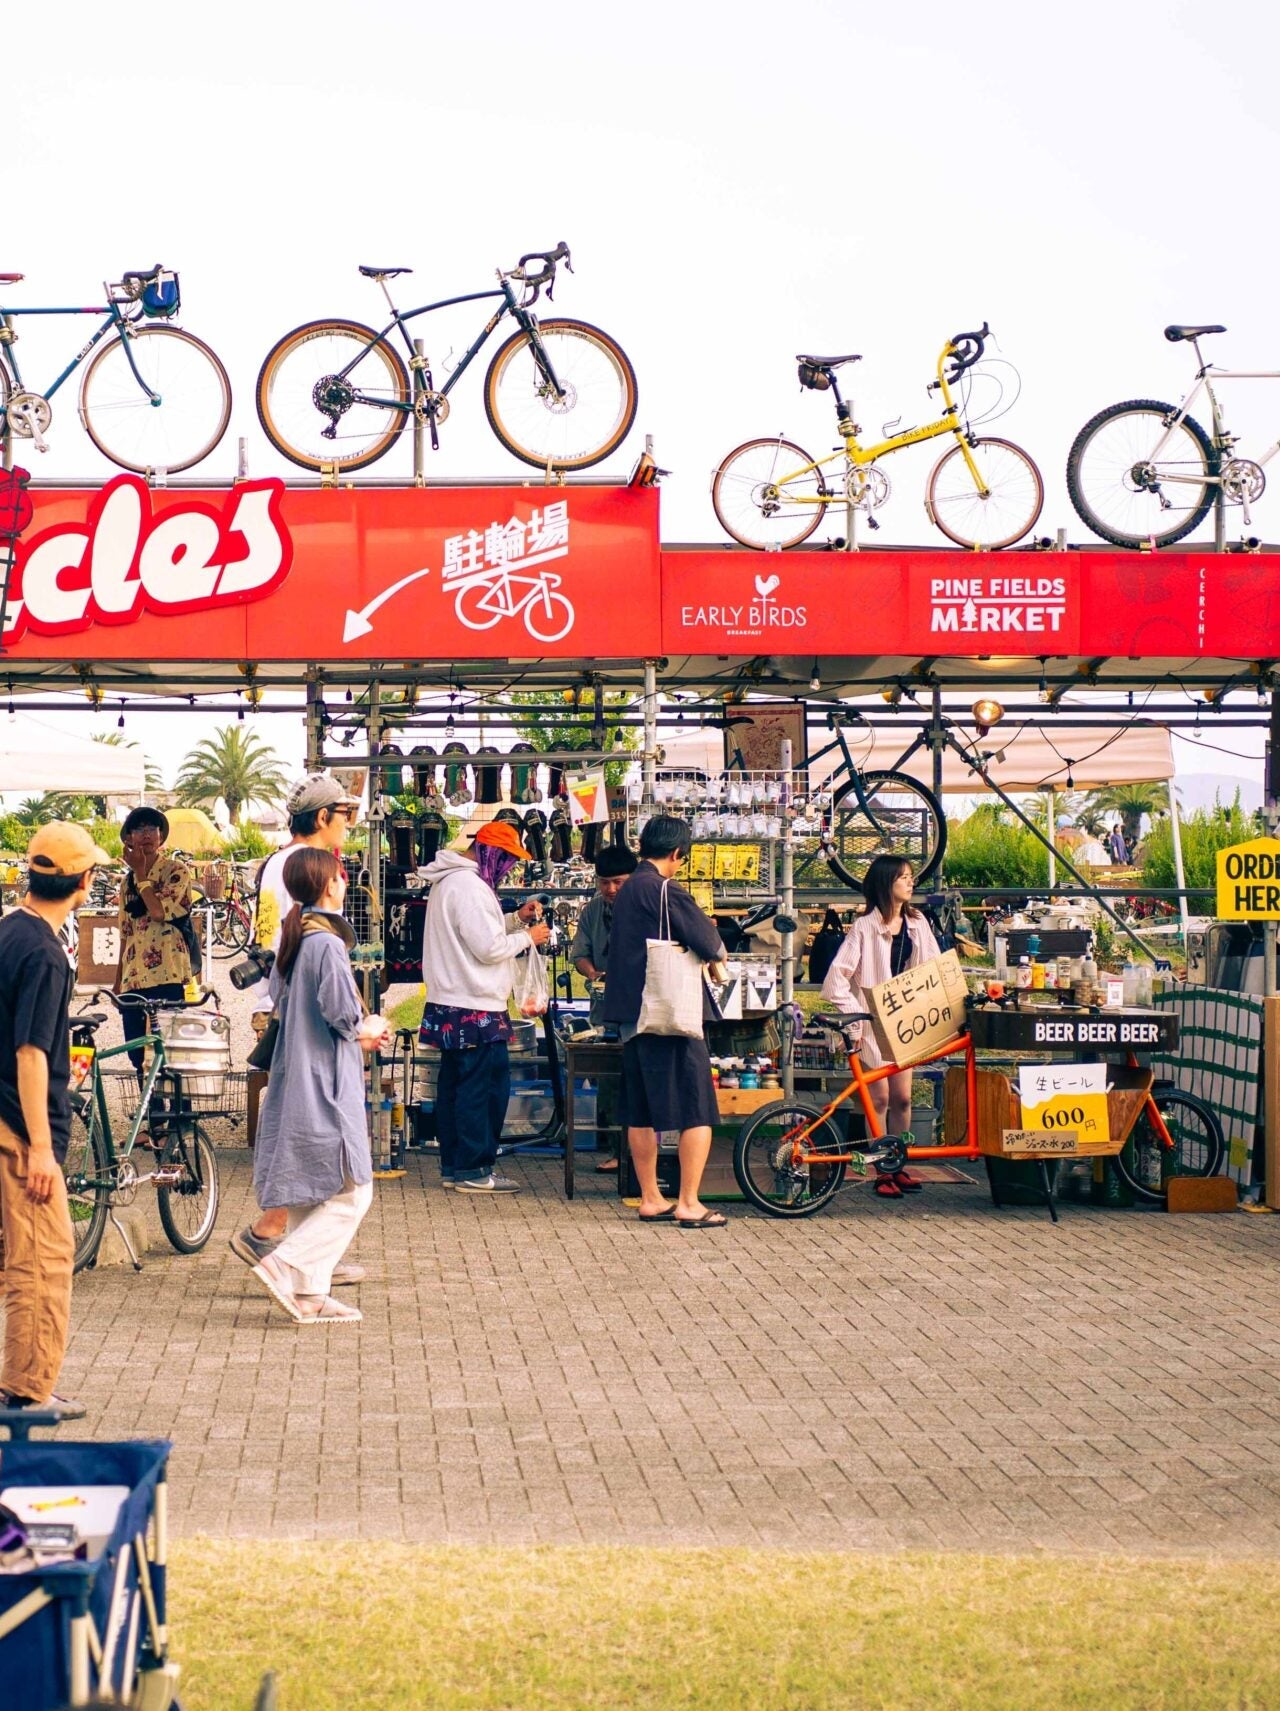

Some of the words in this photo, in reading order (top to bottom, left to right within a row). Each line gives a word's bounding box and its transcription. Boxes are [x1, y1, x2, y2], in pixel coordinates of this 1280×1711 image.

[900, 427, 921, 441] BIKE
[920, 416, 951, 435] FRIDAY
[441, 499, 570, 579] 駐輪場
[931, 579, 982, 596] PINE
[990, 579, 1065, 596] FIELDS
[682, 606, 743, 626] EARLY
[749, 606, 807, 627] BIRDS
[882, 974, 939, 1017] 生ビール
[897, 1006, 951, 1044] 600円
[1035, 1023, 1074, 1042] BEER
[1078, 1023, 1117, 1042] BEER
[1120, 1024, 1159, 1043] BEER
[1036, 1076, 1093, 1092] 生ビール
